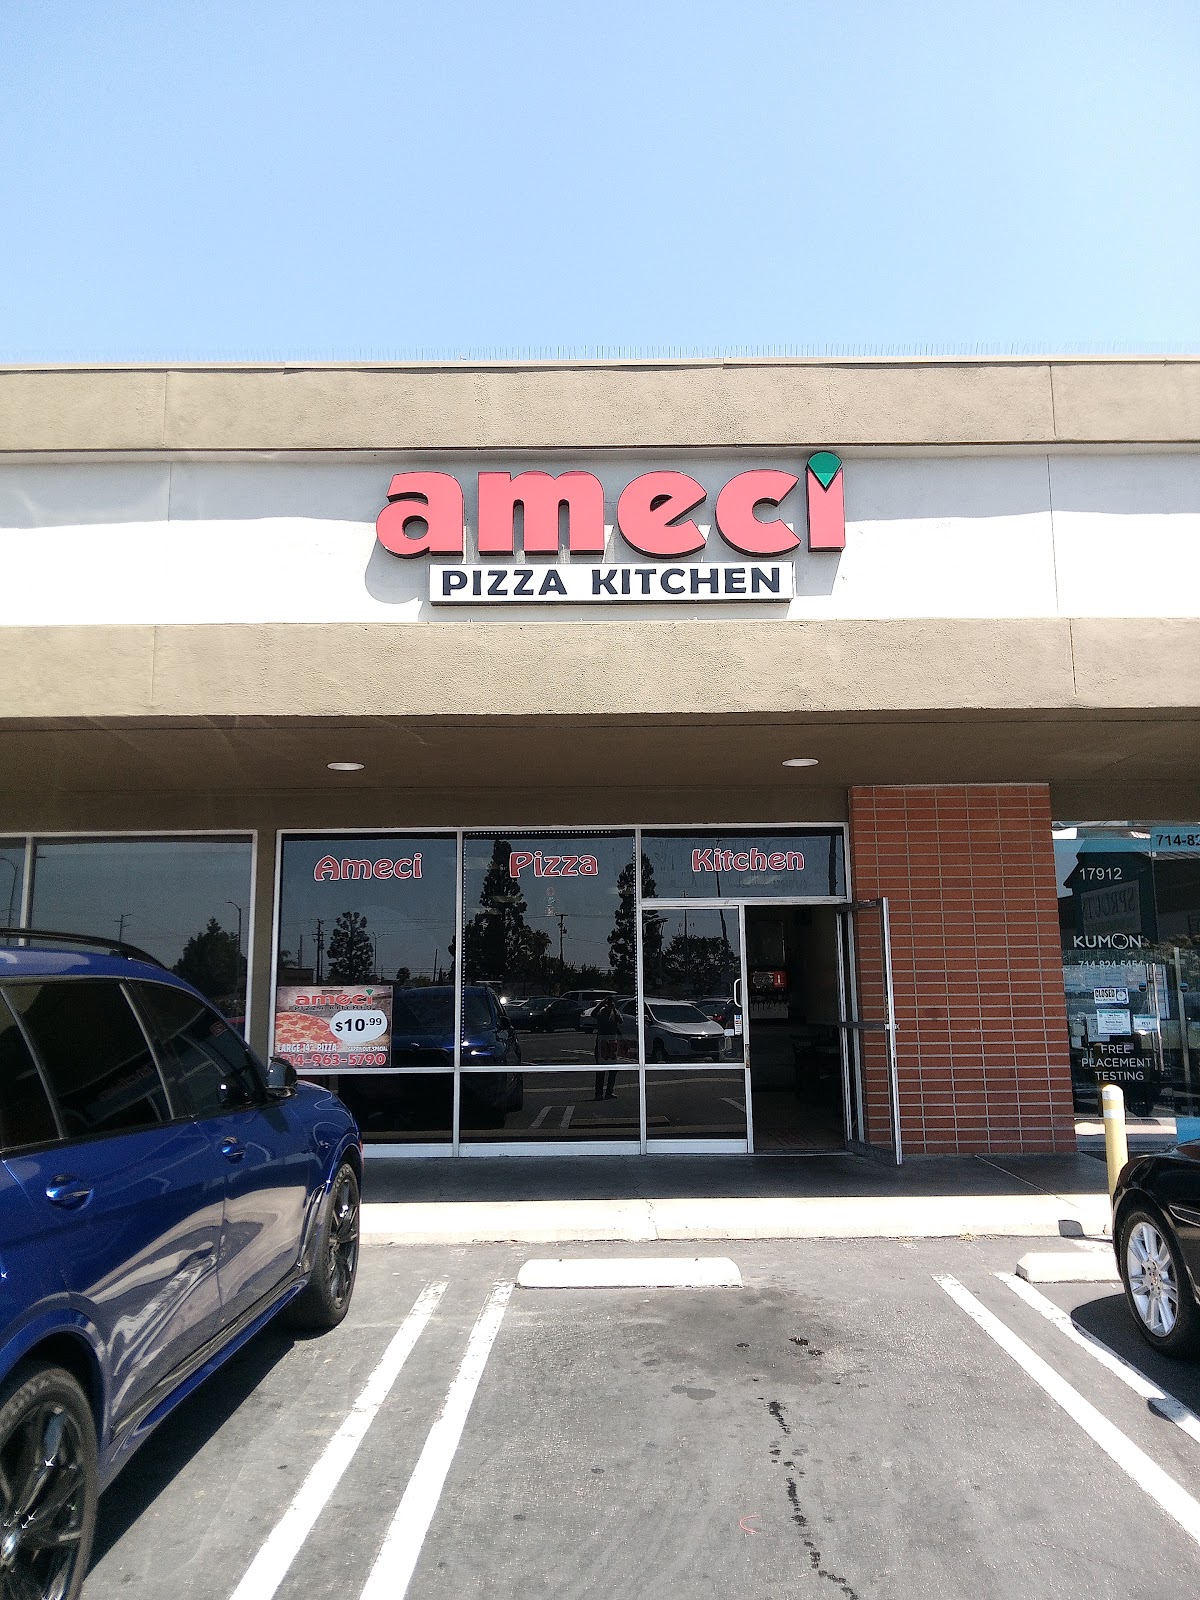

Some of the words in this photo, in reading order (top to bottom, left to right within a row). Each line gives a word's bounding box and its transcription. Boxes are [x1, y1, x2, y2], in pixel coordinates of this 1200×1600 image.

[376, 451, 846, 558] ameci
[442, 568, 567, 596] PIZZA
[591, 567, 781, 595] KITCHEN
[313, 852, 424, 881] Ameci
[508, 849, 599, 878] Pizza
[691, 847, 805, 874] Kitchen
[1079, 867, 1123, 880] 17912
[1073, 933, 1143, 950] KUMON
[295, 989, 374, 1006] ameci
[1095, 989, 1116, 997] CLOSED
[277, 1043, 301, 1052] LARGE
[316, 1043, 337, 1052] PIZZA
[1101, 1044, 1131, 1054] FREE
[1081, 1057, 1152, 1067] PLACEMENT
[1095, 1071, 1145, 1081] TESTING
